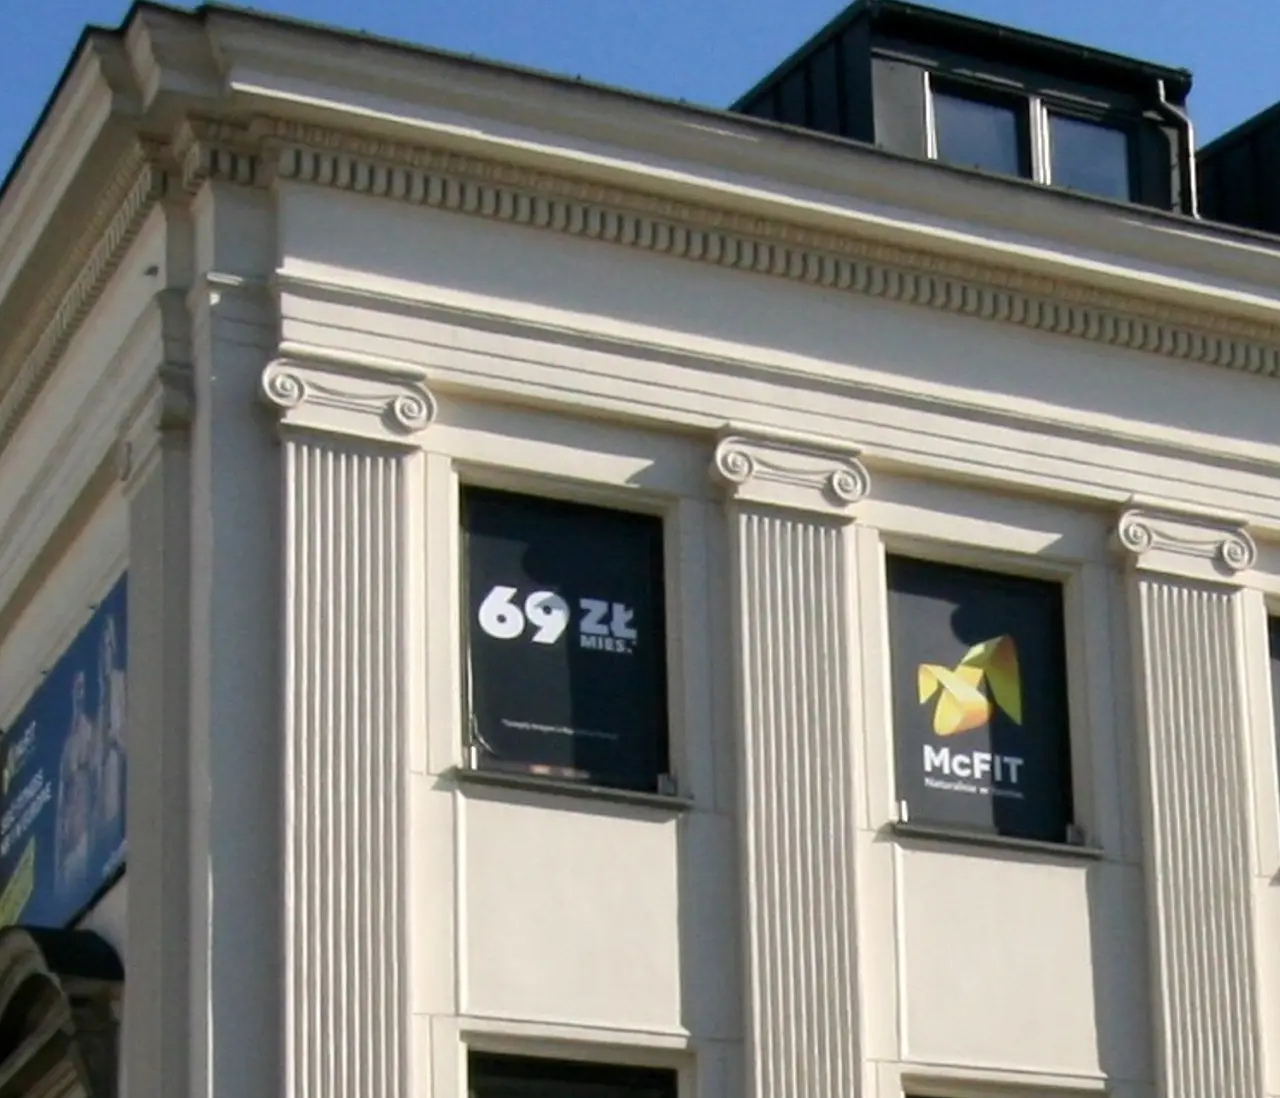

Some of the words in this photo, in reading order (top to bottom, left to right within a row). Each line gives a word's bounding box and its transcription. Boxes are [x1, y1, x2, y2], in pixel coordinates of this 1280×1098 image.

[477, 584, 571, 645] 69
[579, 597, 638, 639] ZŁ
[922, 743, 1025, 784] McFIT
